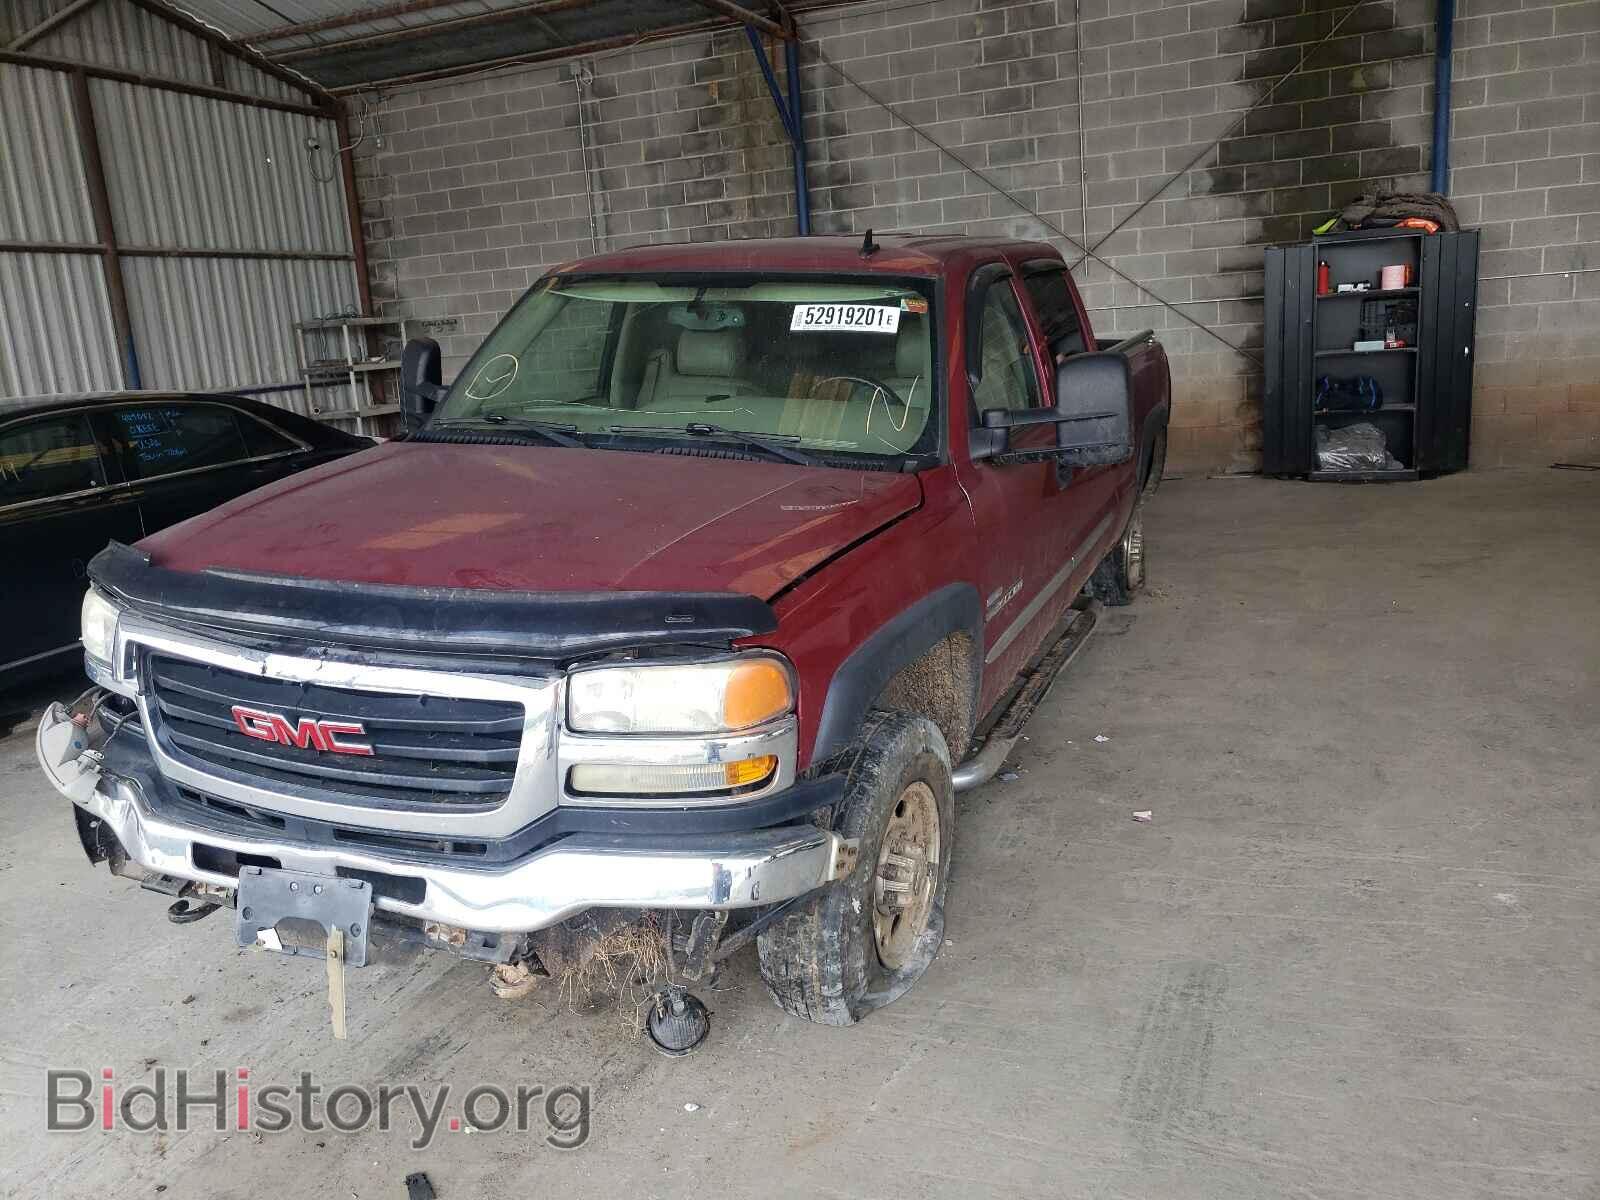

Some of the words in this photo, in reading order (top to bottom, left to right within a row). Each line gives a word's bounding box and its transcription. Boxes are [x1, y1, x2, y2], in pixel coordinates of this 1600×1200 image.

[804, 306, 885, 326] 52919201
[886, 314, 893, 325] E
[231, 705, 375, 756] GMC
